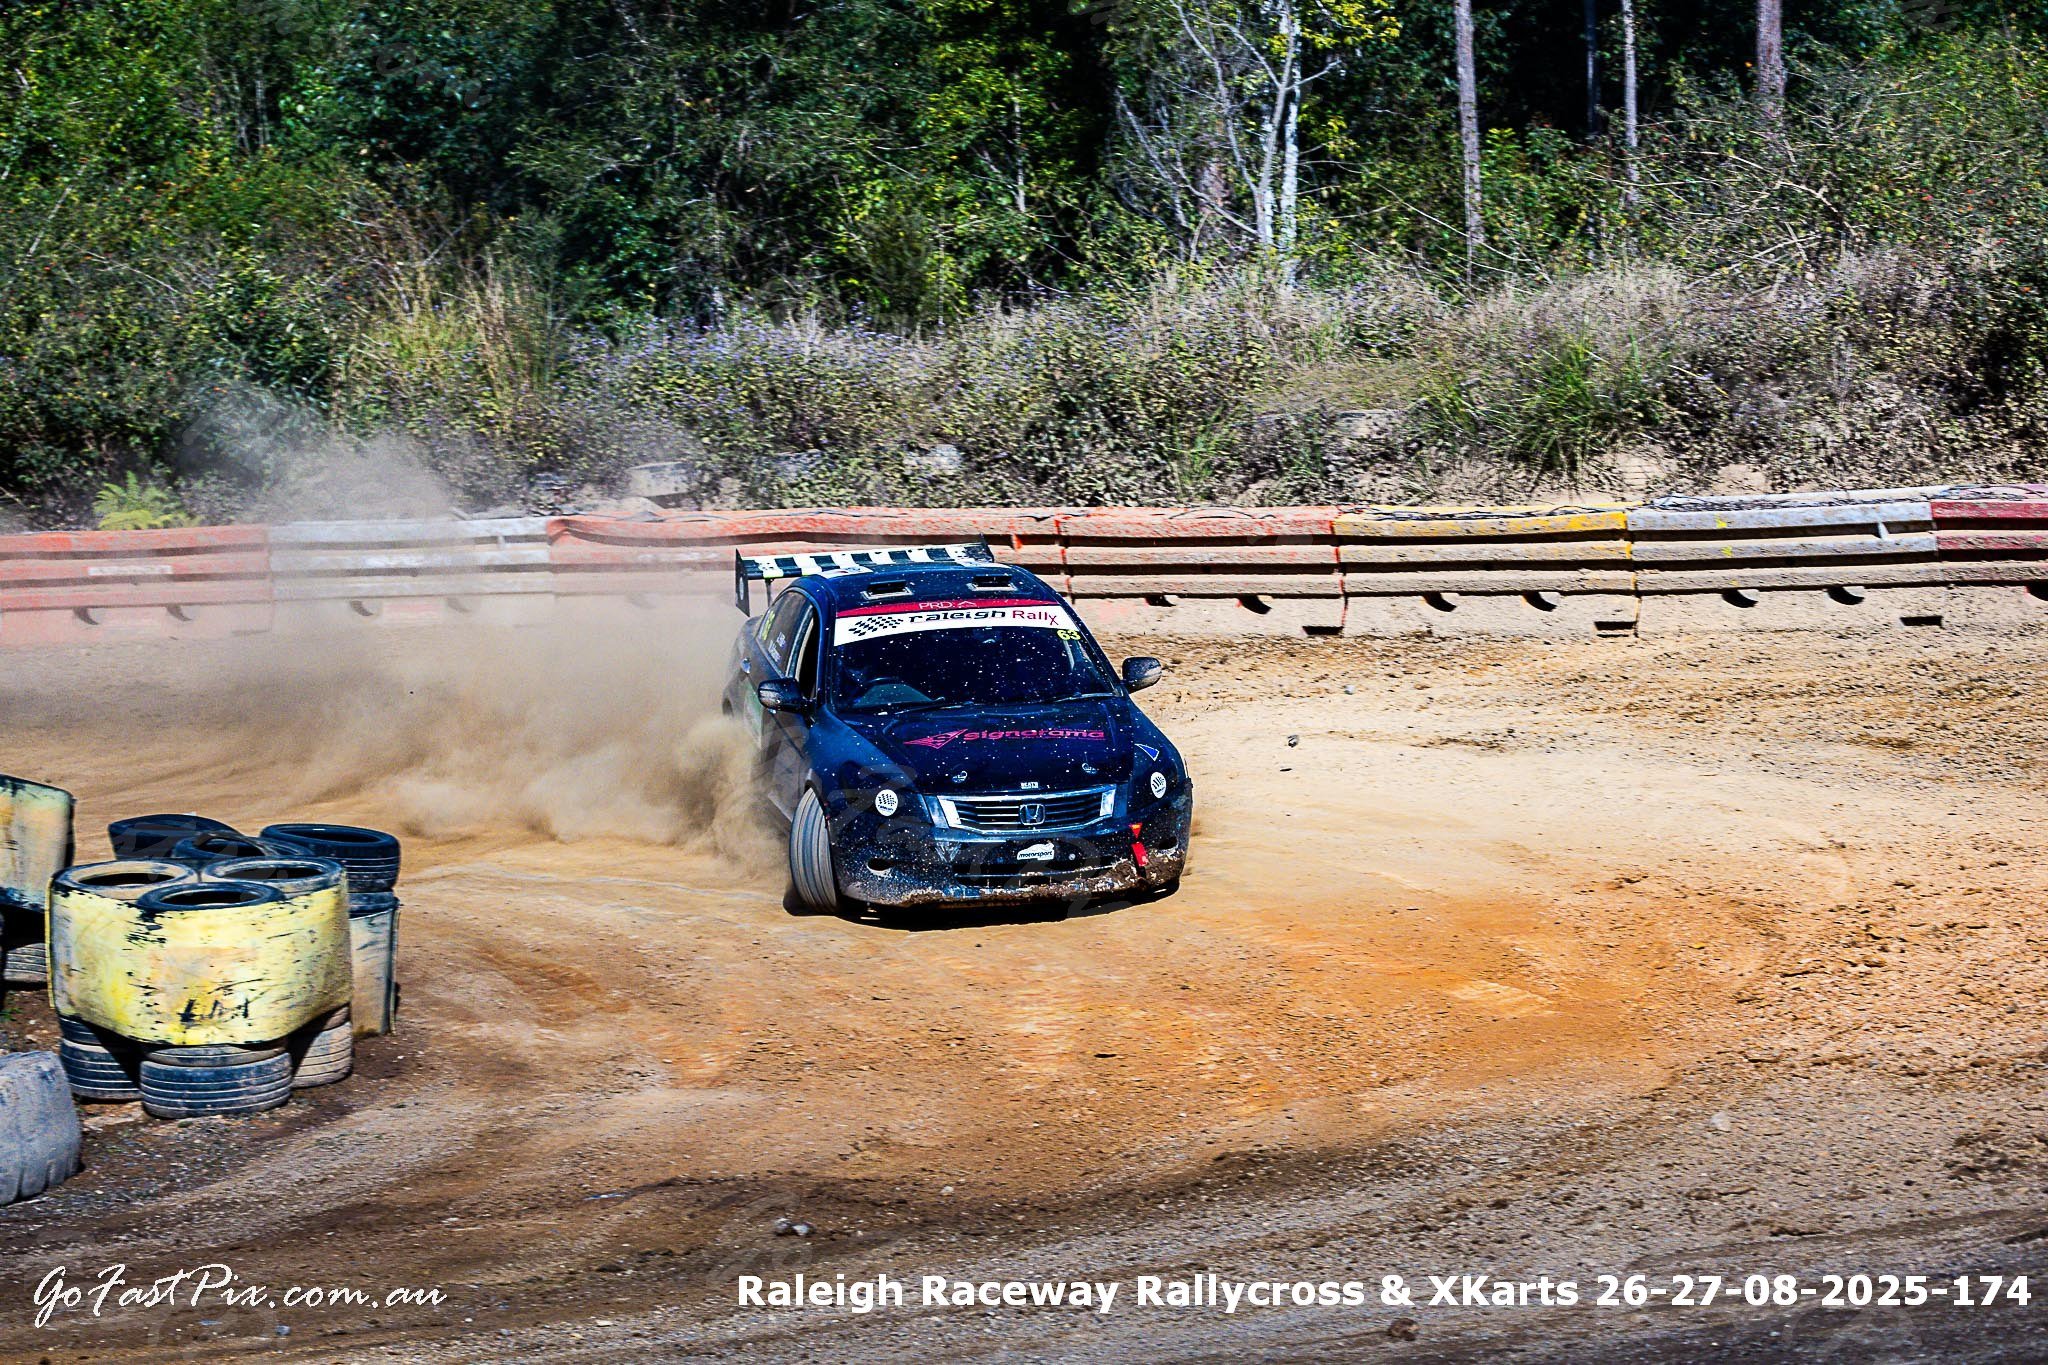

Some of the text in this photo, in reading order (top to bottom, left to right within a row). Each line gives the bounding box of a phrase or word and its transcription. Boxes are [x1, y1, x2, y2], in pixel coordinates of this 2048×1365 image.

[909, 611, 1006, 624] raleigh
[1056, 629, 1081, 641] 63
[1018, 850, 1053, 859] motorsport
